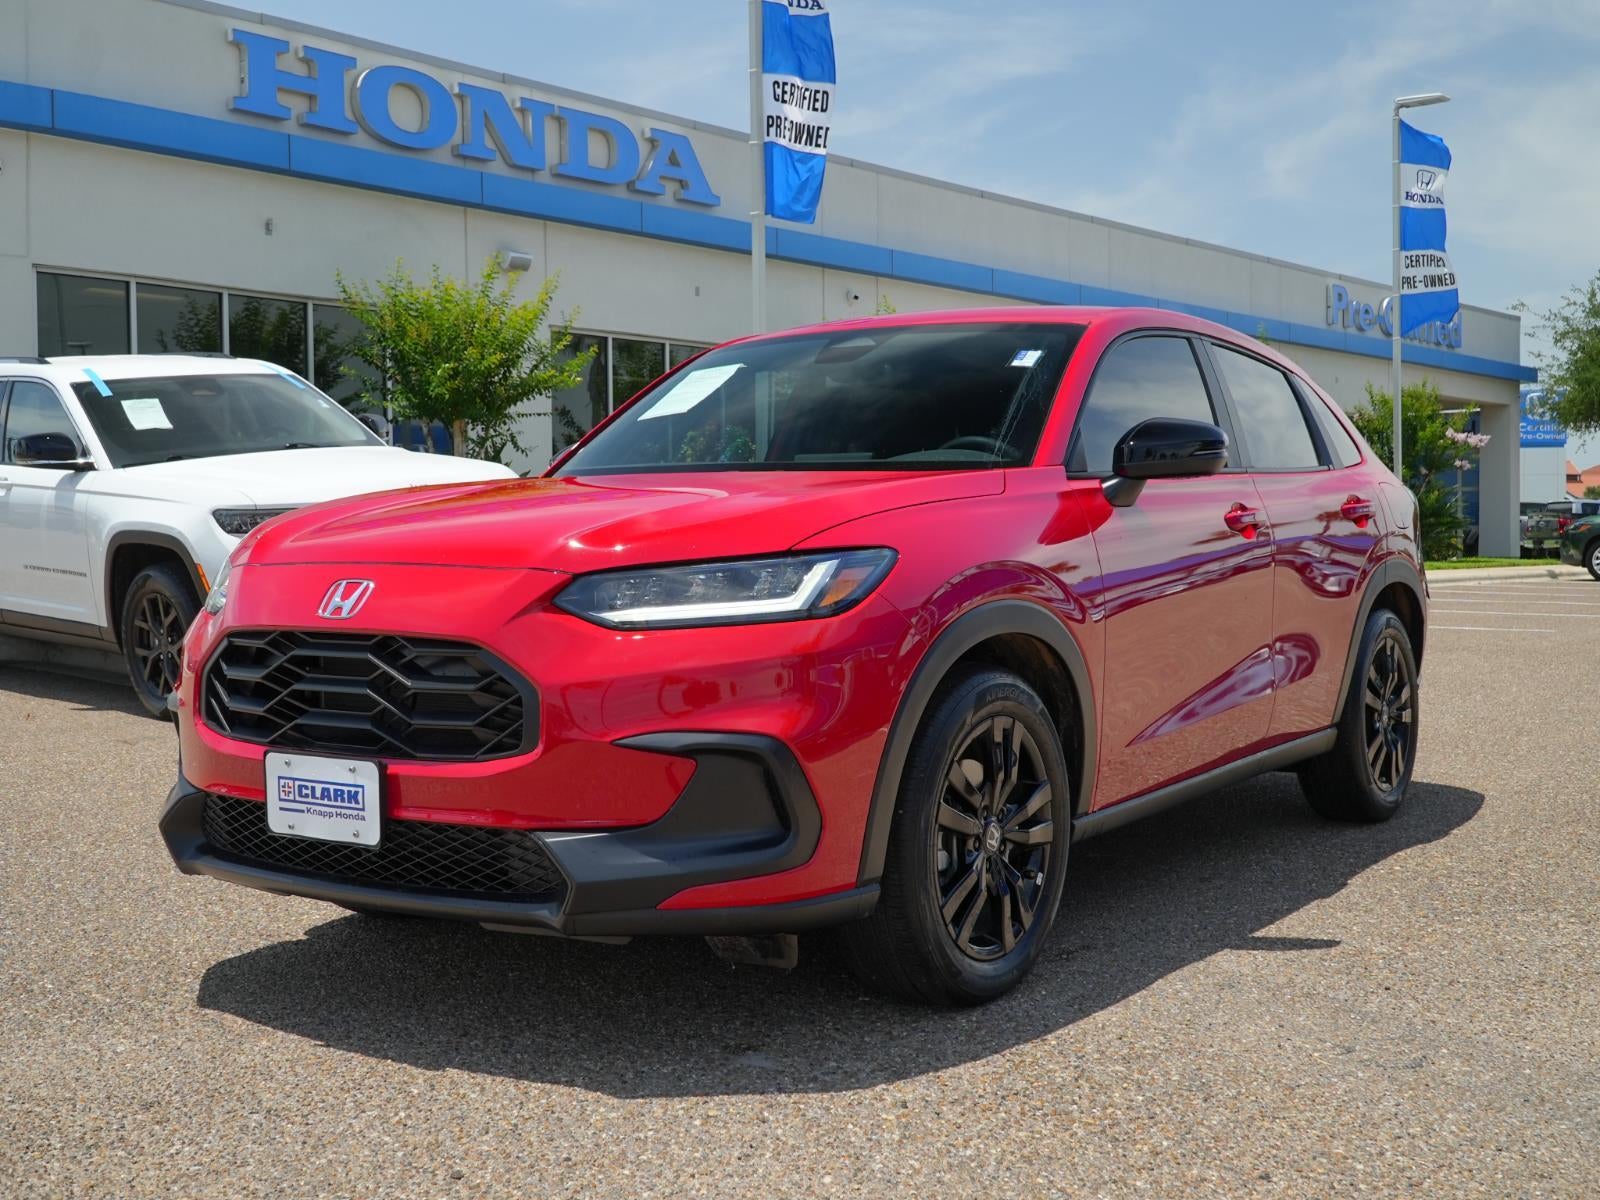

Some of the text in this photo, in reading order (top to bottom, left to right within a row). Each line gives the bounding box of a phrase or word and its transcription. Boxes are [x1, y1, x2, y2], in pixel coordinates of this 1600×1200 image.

[772, 80, 830, 113] CERTIFIED
[227, 27, 721, 207] HONDA
[1401, 272, 1456, 290] PRE-OWNED
[297, 783, 361, 806] CLARK
[305, 806, 366, 822] Knapp Honda
